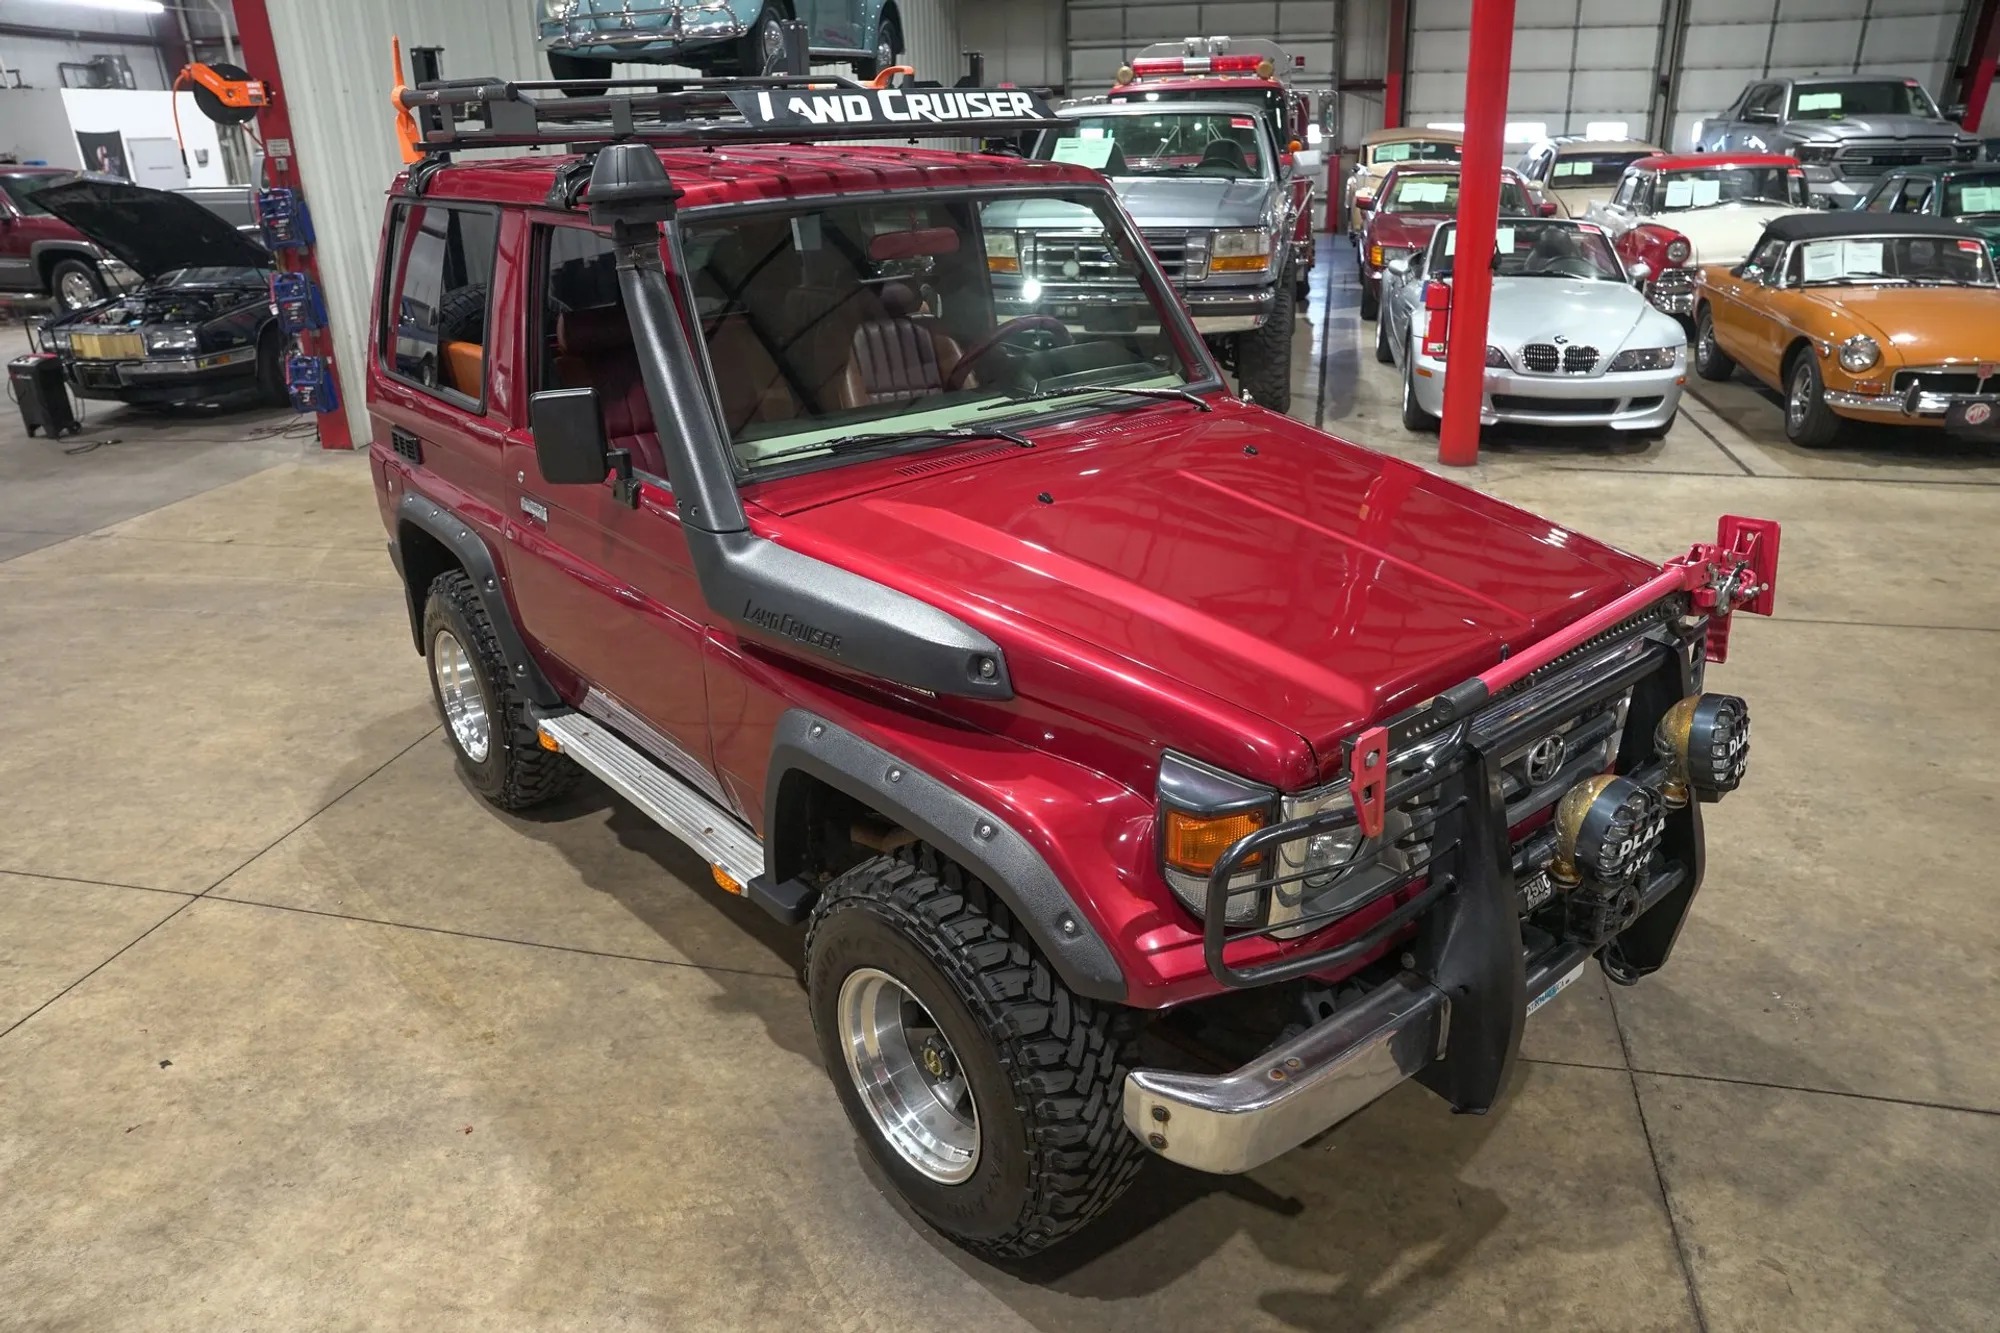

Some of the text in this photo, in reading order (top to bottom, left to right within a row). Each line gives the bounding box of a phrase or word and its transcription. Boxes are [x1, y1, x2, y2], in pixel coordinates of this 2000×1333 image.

[877, 89, 1044, 123] CRUISER
[743, 599, 841, 656] LAND CRUISER
[1619, 817, 1665, 857] DLAA
[1625, 851, 1651, 876] 4X4
